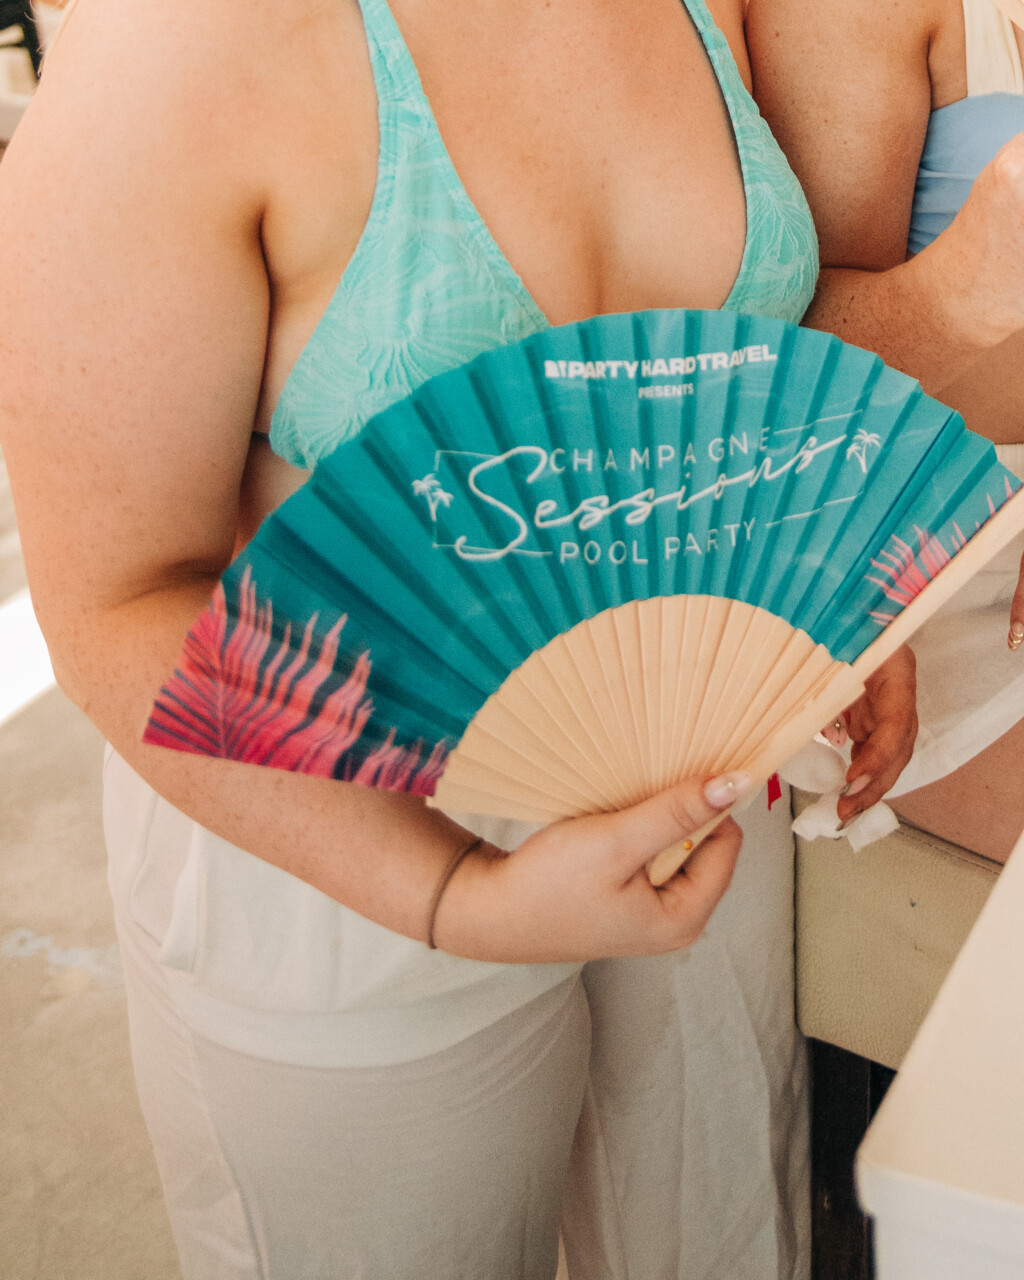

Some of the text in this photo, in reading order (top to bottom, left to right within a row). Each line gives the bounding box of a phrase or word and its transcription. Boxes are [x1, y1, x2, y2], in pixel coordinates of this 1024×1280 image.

[568, 344, 778, 379] PARTY HARD TRAVEL
[638, 383, 694, 399] PESENTS
[550, 427, 770, 474] CHAMPAGNE
[455, 434, 849, 561] Sessions
[559, 517, 756, 565] POOL PARTY
